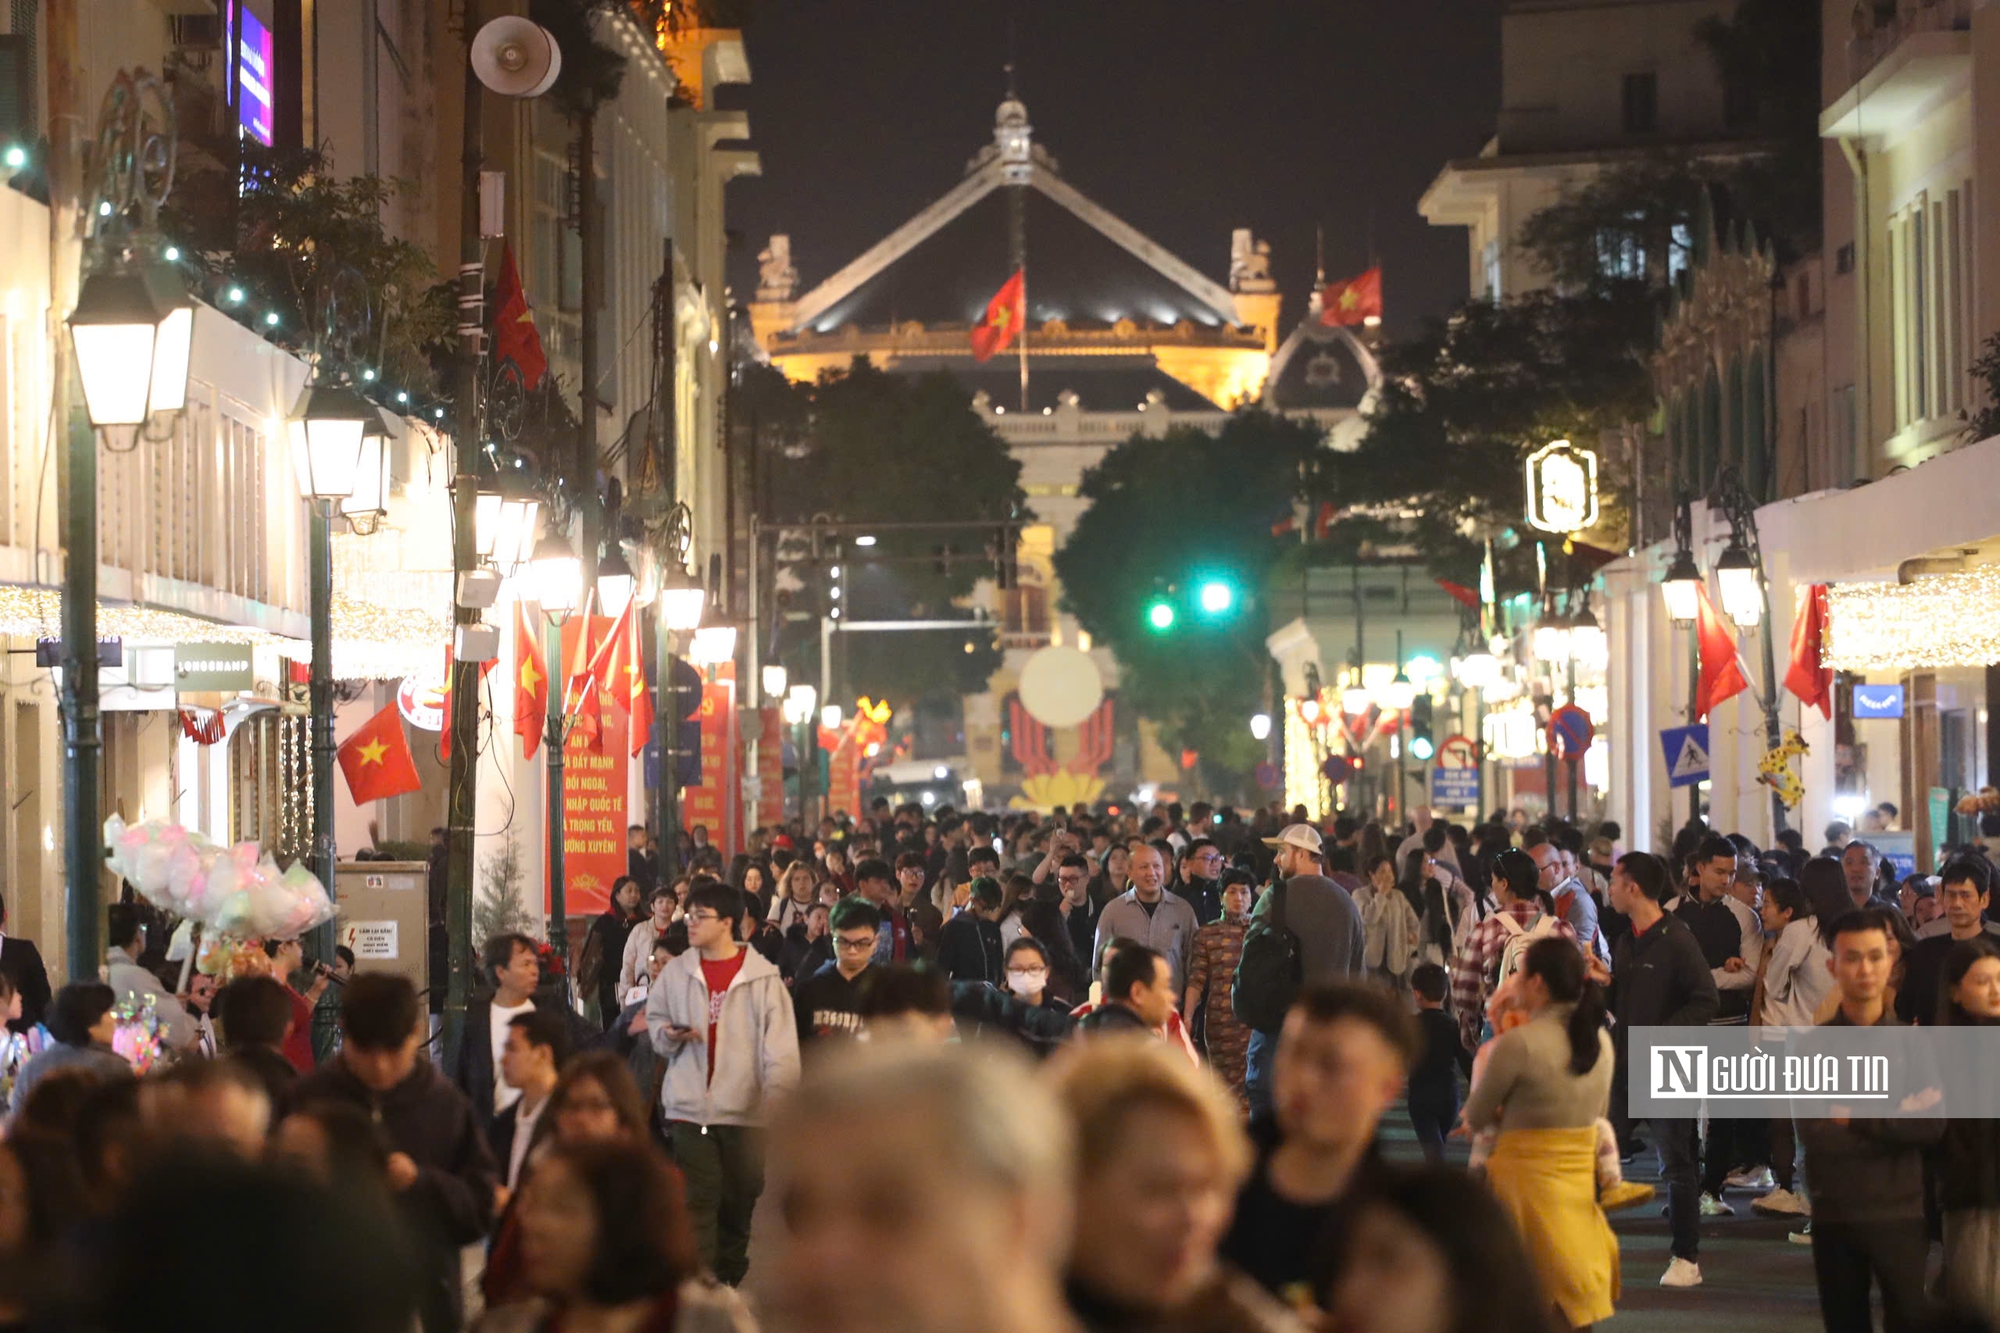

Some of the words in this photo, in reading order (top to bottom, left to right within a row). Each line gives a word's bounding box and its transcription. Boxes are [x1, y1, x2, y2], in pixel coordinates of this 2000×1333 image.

[590, 794, 611, 812] QUỐC
[613, 795, 622, 811] TẾ
[569, 818, 595, 835] TRỌNG
